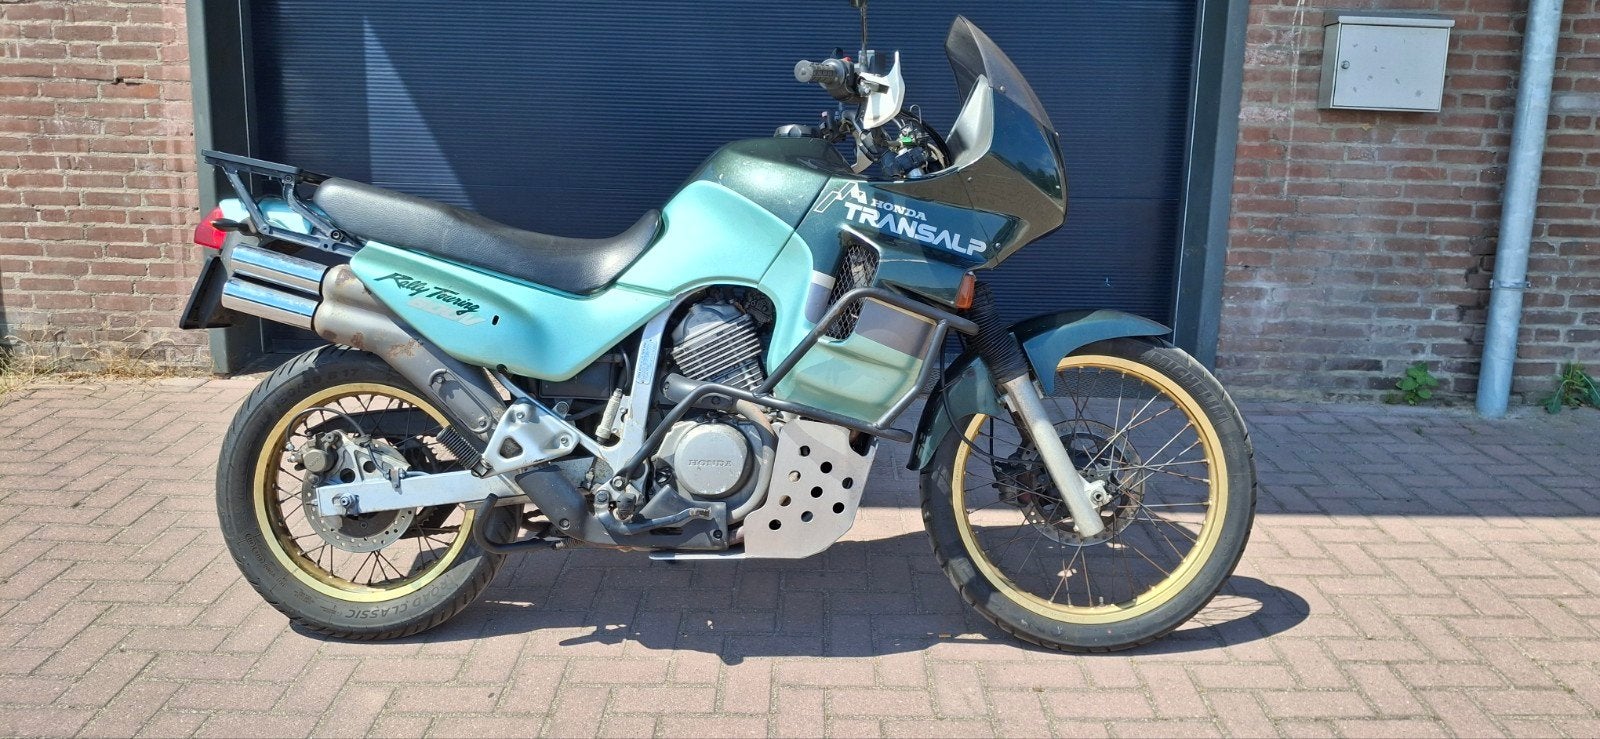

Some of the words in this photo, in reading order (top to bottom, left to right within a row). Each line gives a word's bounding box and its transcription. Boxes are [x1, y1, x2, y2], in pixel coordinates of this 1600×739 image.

[870, 198, 928, 222] HONDA
[844, 201, 987, 256] TRANSALP
[373, 272, 430, 297] Rally
[426, 286, 480, 316] Touring
[688, 459, 733, 467] HONDA
[410, 579, 449, 607] ROAD
[344, 601, 409, 620] CLASSIC
